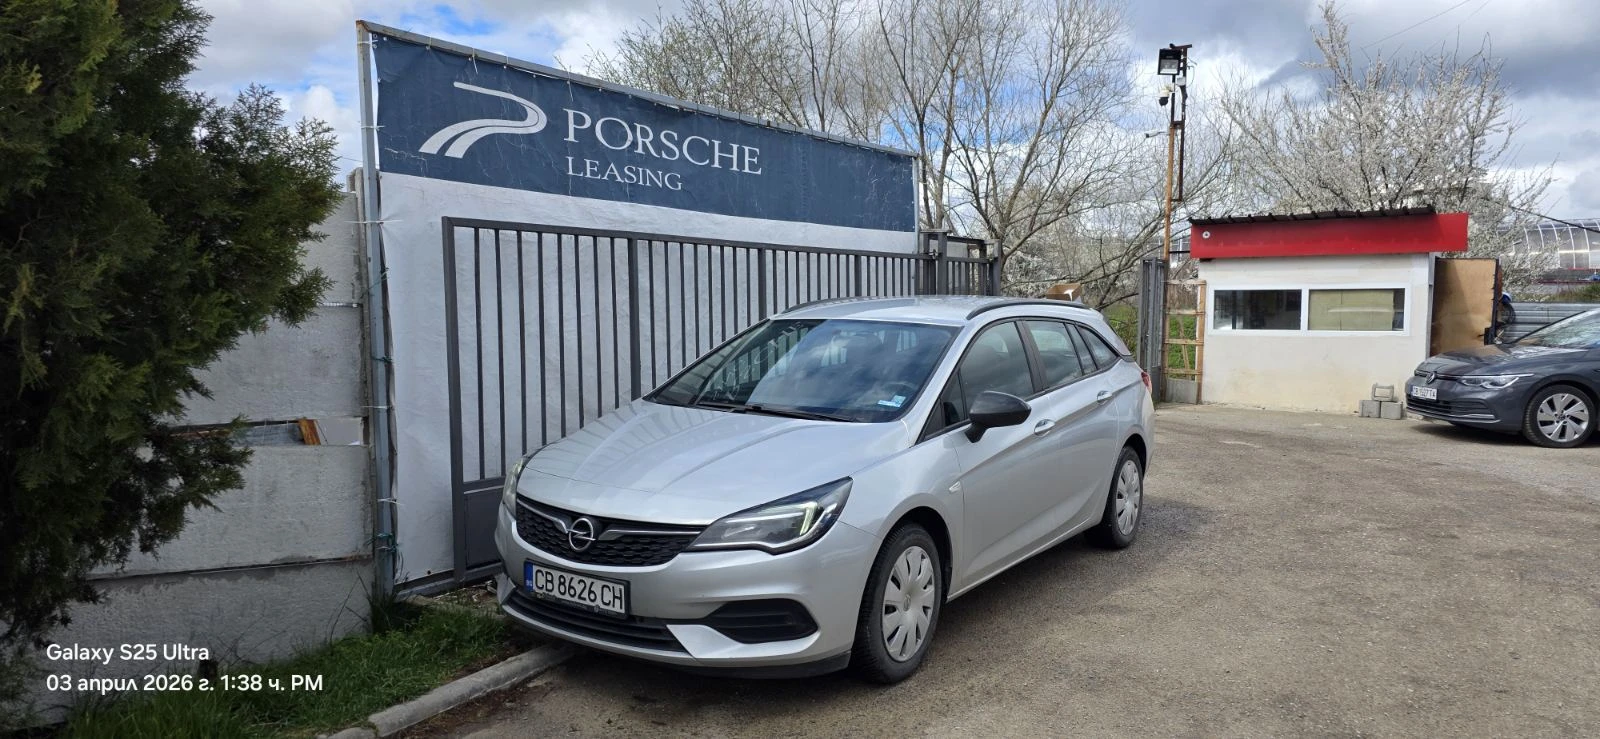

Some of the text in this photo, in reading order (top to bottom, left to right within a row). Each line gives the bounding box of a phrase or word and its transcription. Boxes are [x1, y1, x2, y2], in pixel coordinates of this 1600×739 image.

[562, 108, 762, 175] PORSCHE
[565, 156, 682, 191] LEASING
[535, 569, 623, 610] CB 8626 CH
